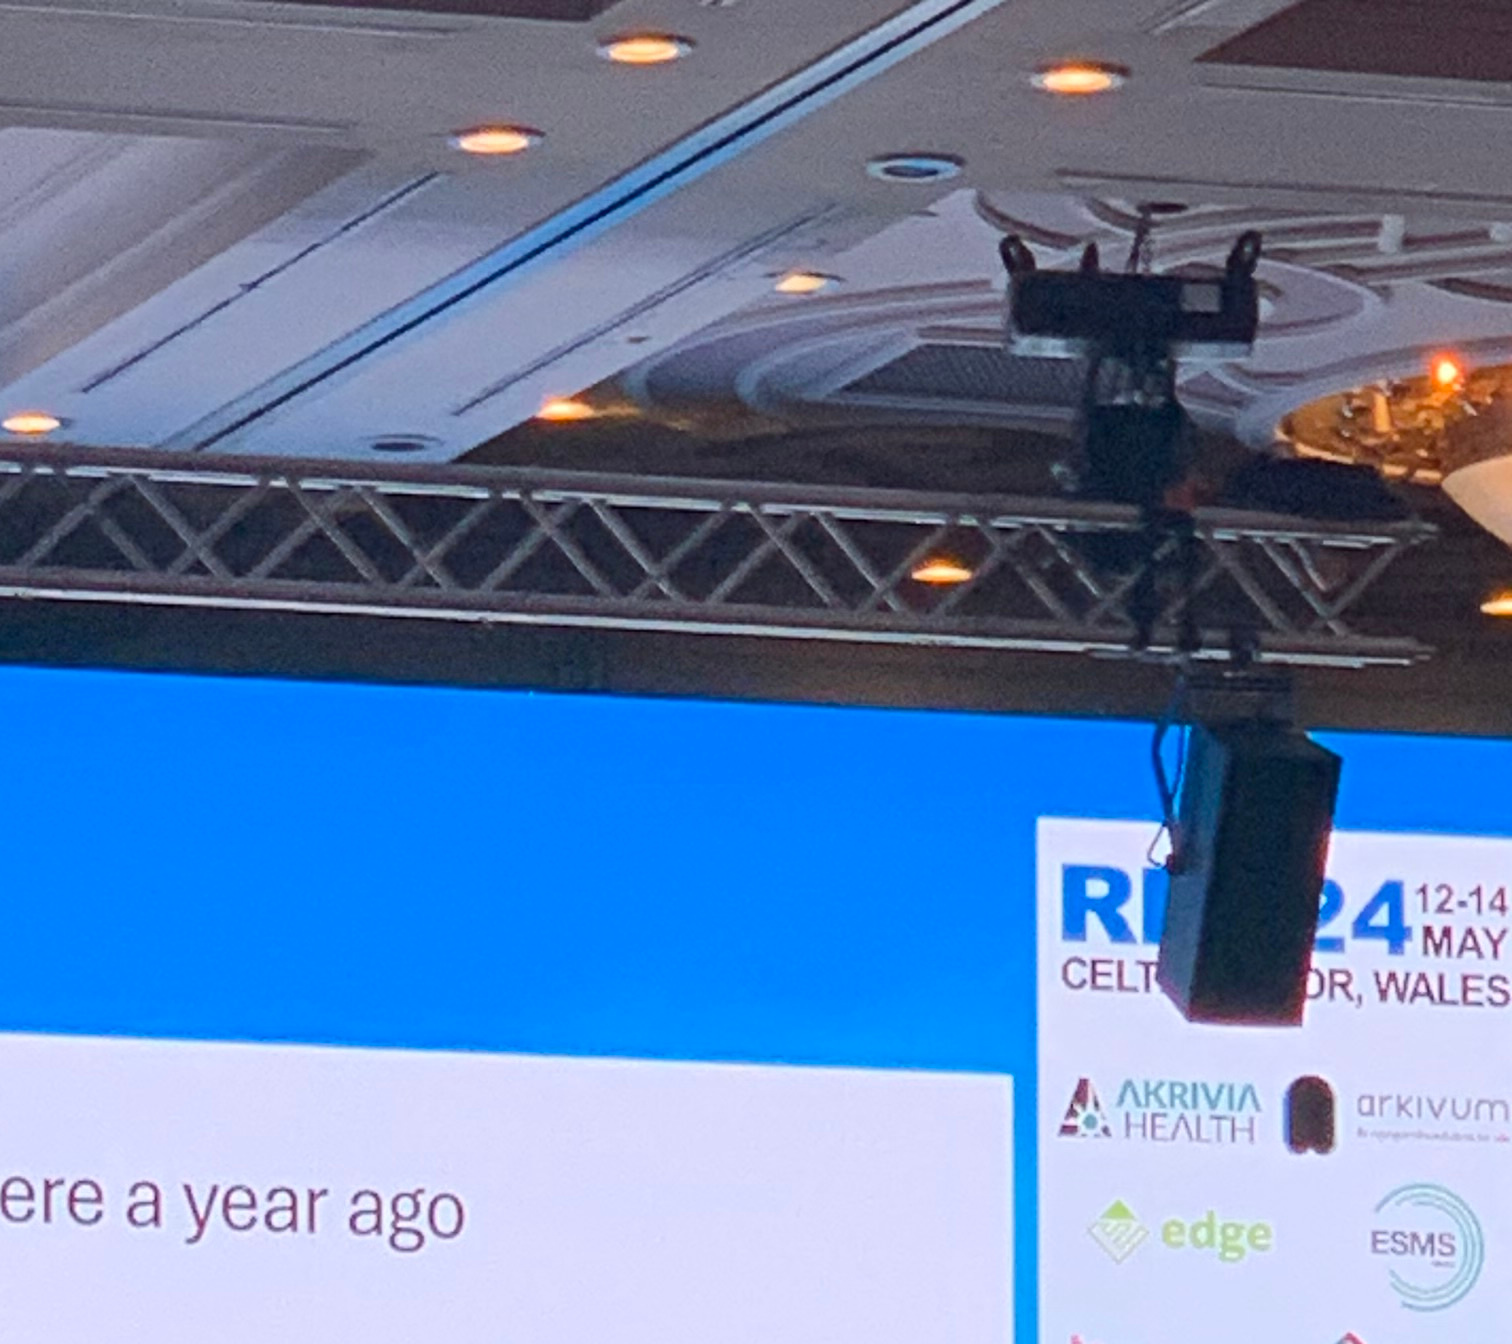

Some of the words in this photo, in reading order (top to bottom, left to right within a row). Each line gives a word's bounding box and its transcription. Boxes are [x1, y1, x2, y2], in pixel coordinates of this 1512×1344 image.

[1417, 884, 1507, 916] 12-14
[1423, 926, 1507, 959] MAY
[1374, 971, 1510, 1007] WALES
[1117, 1080, 1260, 1113] AKRIVIA
[1357, 1095, 1509, 1121] arkivum
[1125, 1112, 1255, 1142] HEALTH
[127, 1181, 160, 1227] a
[184, 1184, 328, 1244] year
[349, 1189, 464, 1252] ago
[1162, 1211, 1270, 1262] edge
[1372, 1231, 1455, 1257] ESMS
